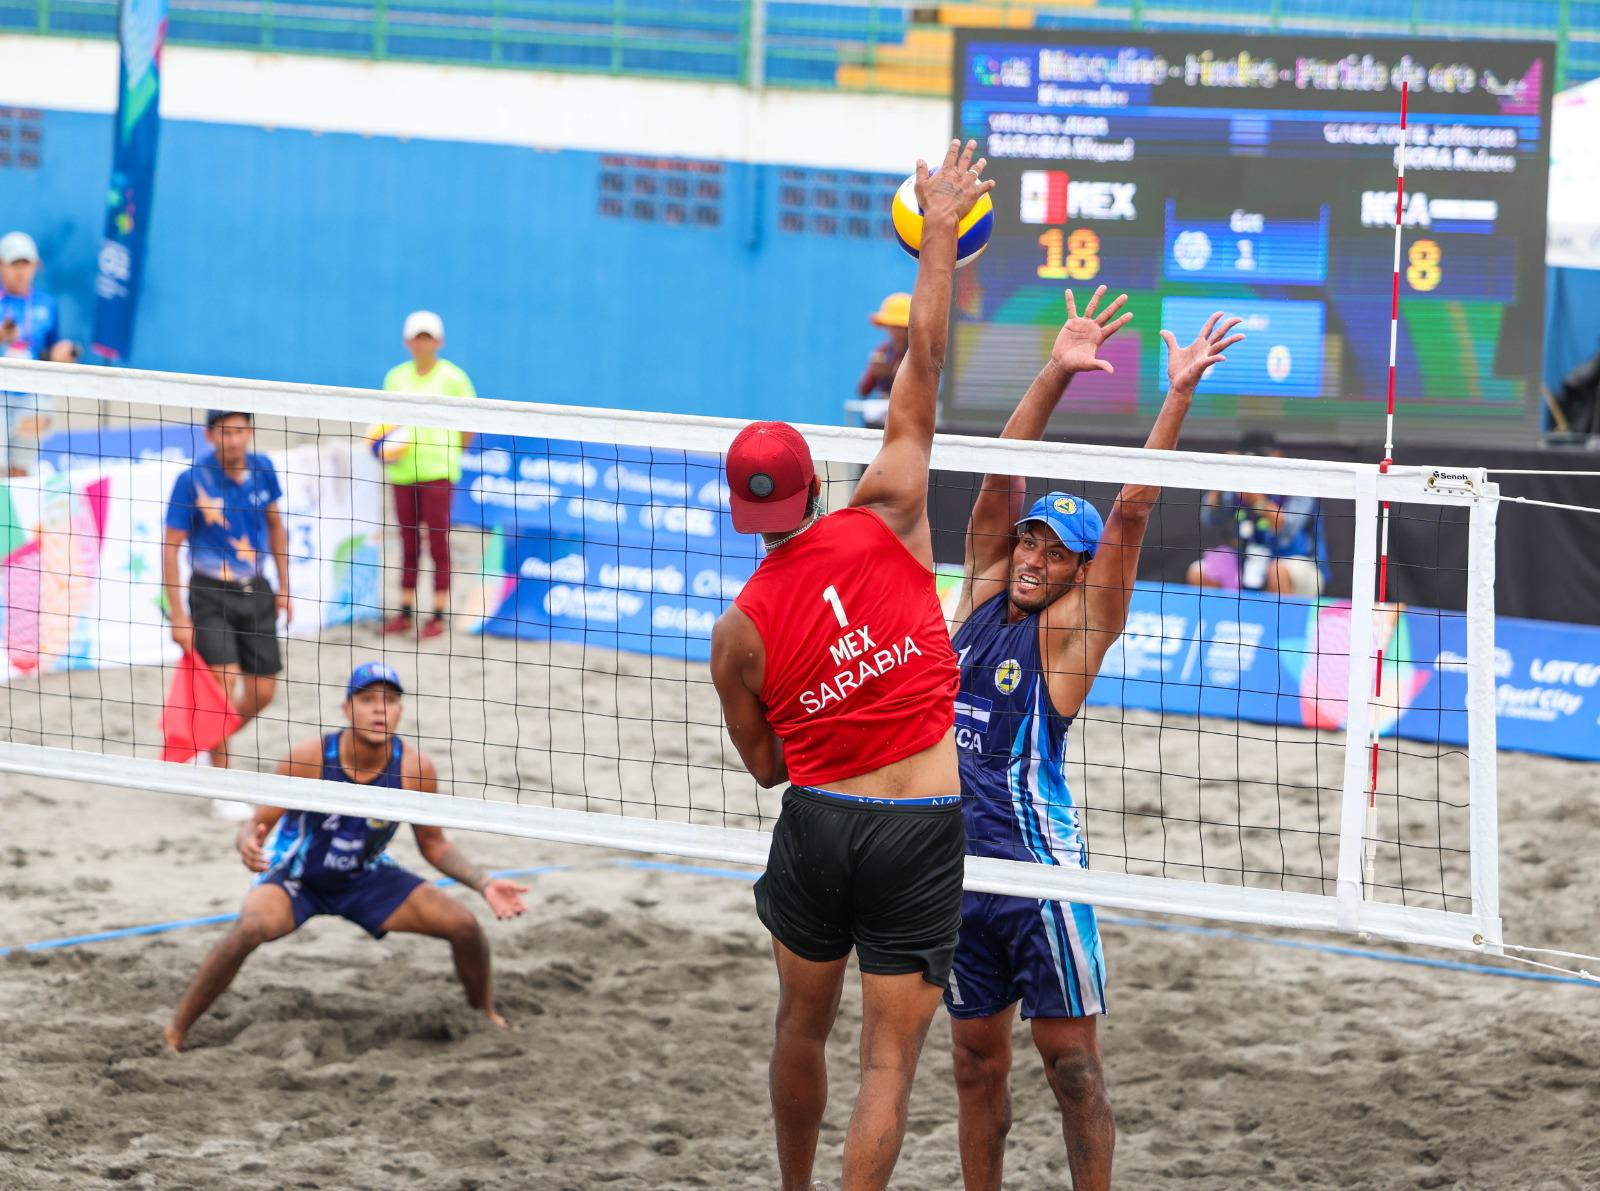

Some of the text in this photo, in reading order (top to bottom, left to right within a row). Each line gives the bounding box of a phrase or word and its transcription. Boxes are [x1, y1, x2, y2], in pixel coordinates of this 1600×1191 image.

[1067, 181, 1137, 220] MEX
[1361, 190, 1430, 228] NCA
[1037, 227, 1101, 280] 18
[1234, 239, 1257, 271] 1
[1406, 239, 1442, 292] 8
[1266, 345, 1292, 383] 0
[1440, 472, 1469, 481] Senoh
[822, 584, 849, 629] 1
[828, 625, 877, 667] MEX
[799, 635, 923, 715] SARABIA
[954, 726, 983, 754] CA
[323, 852, 359, 870] NCA
